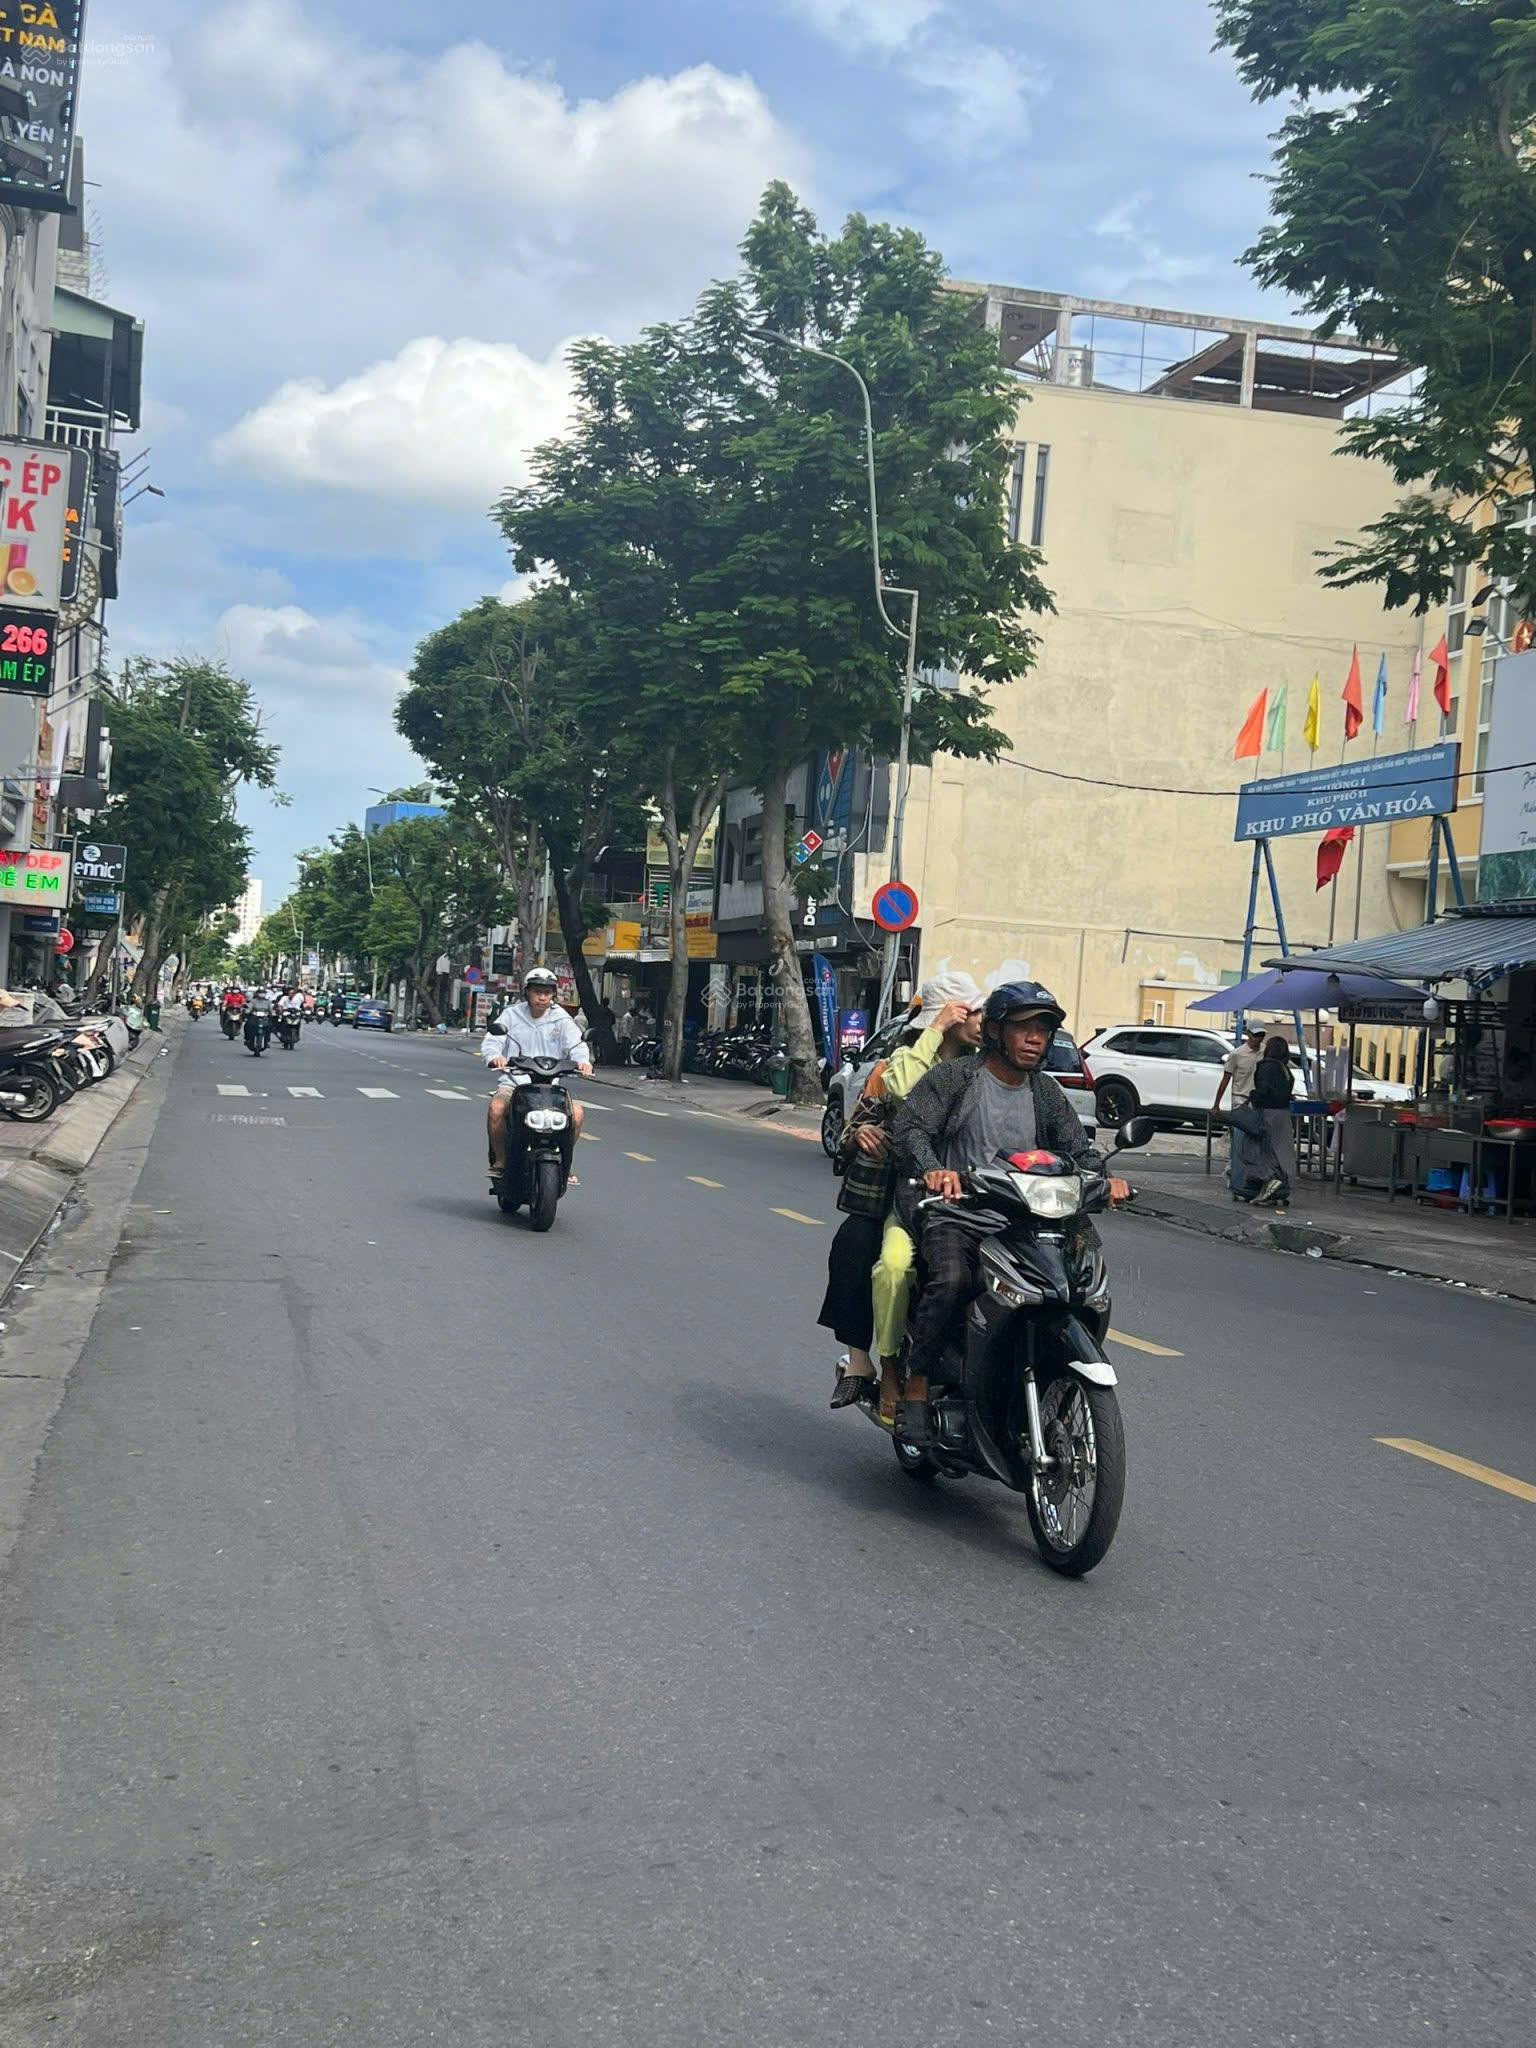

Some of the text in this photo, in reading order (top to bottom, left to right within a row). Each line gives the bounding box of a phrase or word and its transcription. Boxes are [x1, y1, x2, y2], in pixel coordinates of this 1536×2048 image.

[21, 2, 58, 28] GÀ
[19, 30, 65, 53] NAM
[21, 64, 64, 87] NON
[22, 453, 61, 496] ÉP
[1, 624, 48, 655] 266
[23, 657, 45, 683] ÉP
[1244, 817, 1285, 836] KHU
[1337, 802, 1381, 821] VĂN
[1384, 790, 1435, 816] HÓA
[1307, 796, 1333, 808] KHU
[26, 873, 60, 891] EM
